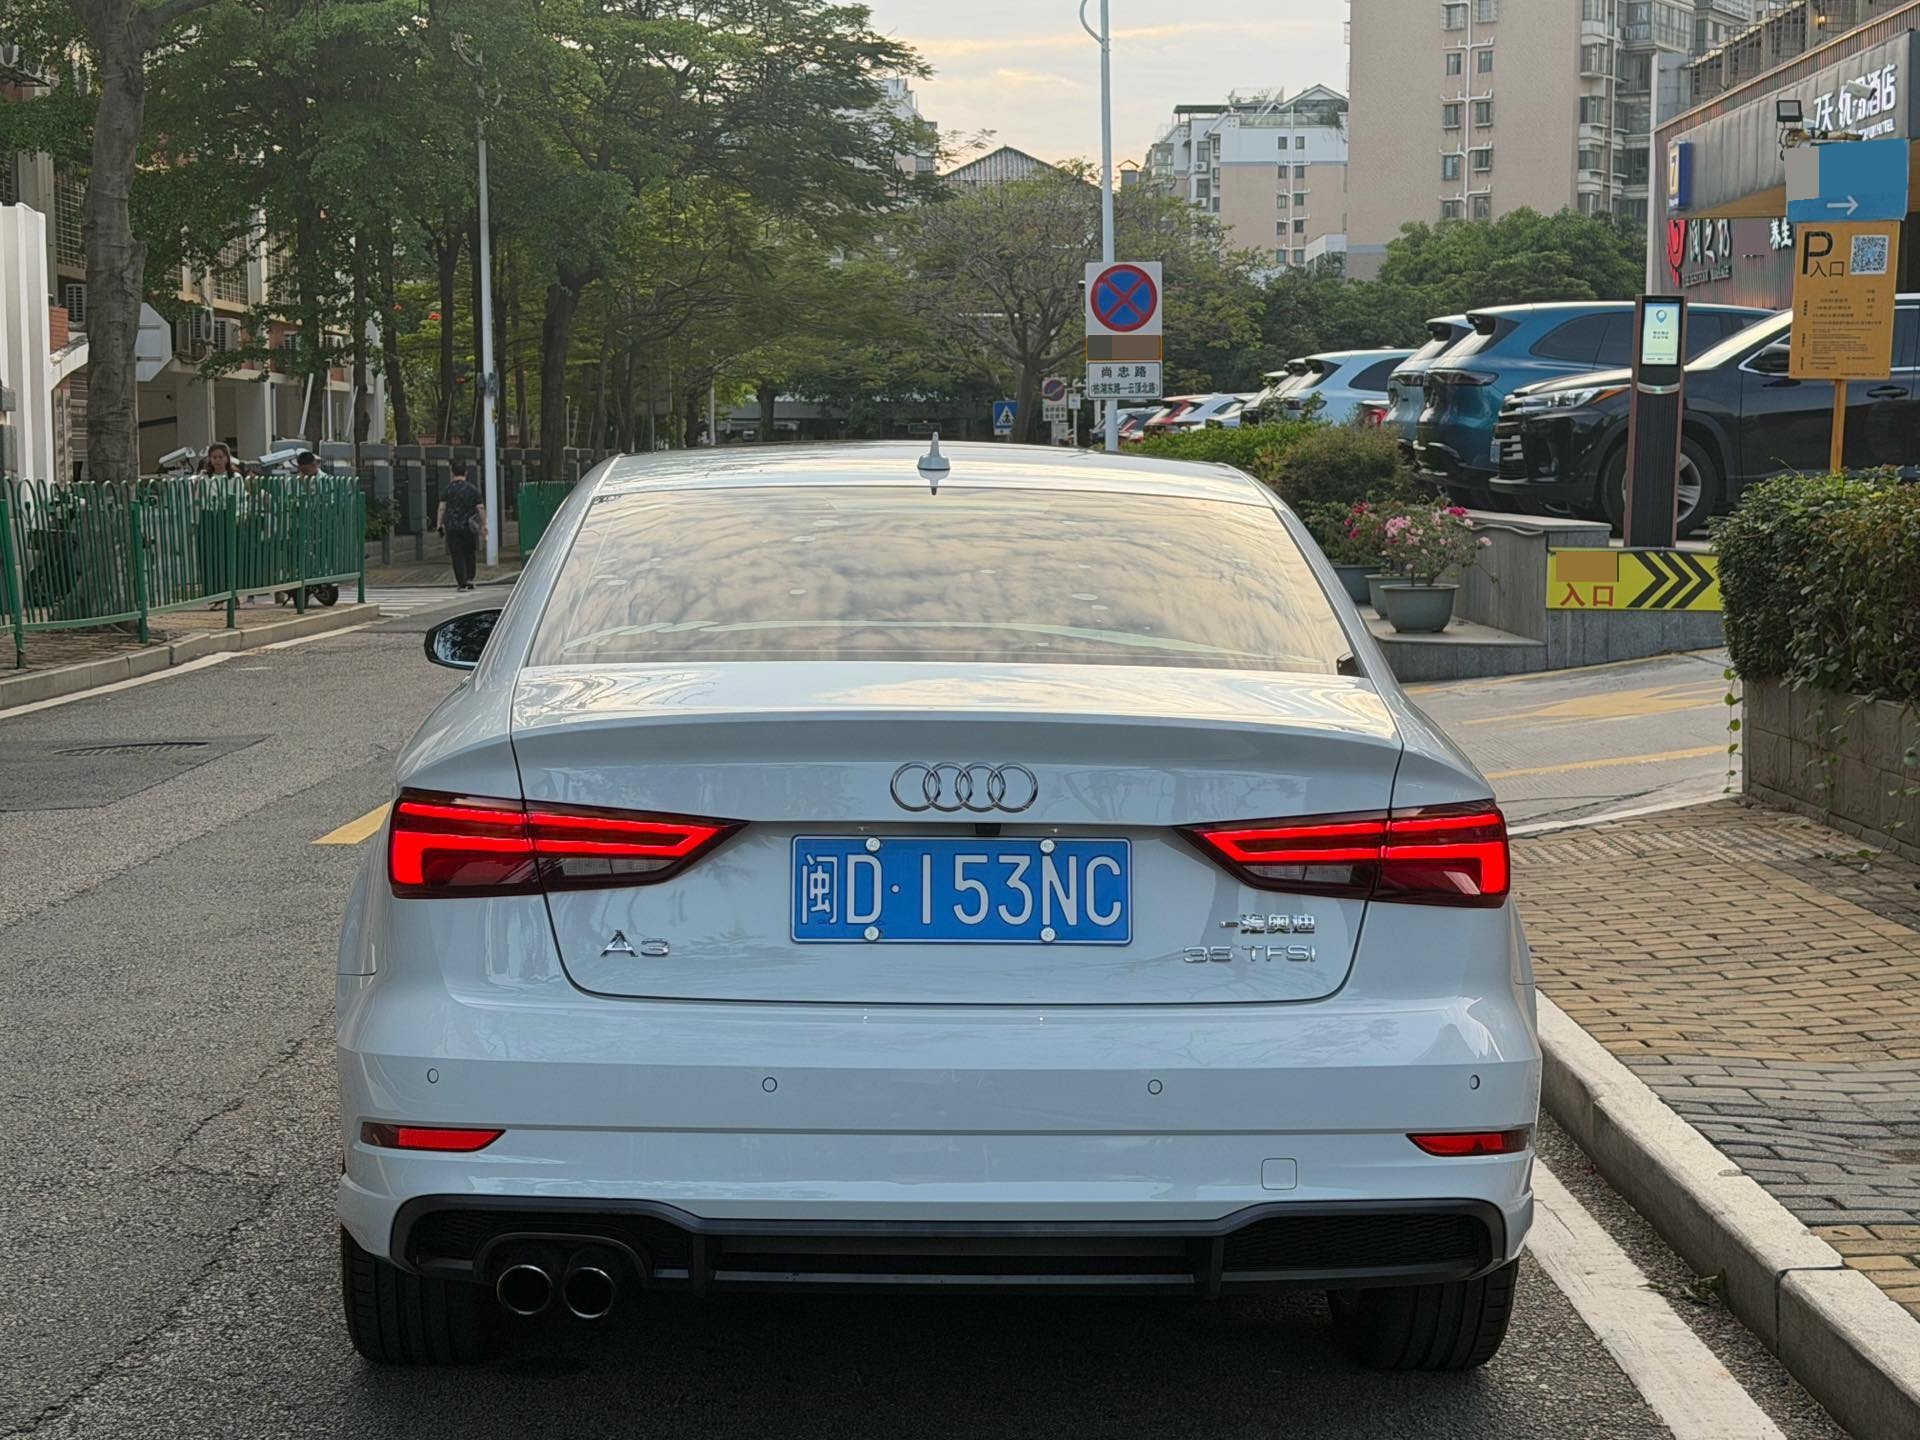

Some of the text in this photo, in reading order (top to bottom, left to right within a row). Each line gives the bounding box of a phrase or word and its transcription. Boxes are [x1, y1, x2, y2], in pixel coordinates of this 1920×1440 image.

[1801, 231, 1834, 275] P
[1809, 260, 1845, 278] 入口
[1101, 366, 1147, 379] 尚忠路
[1560, 582, 1614, 607] 入口
[1219, 913, 1316, 934] 一汽奥迪
[600, 929, 670, 958] A3
[1183, 945, 1317, 963] 35 TFSI
